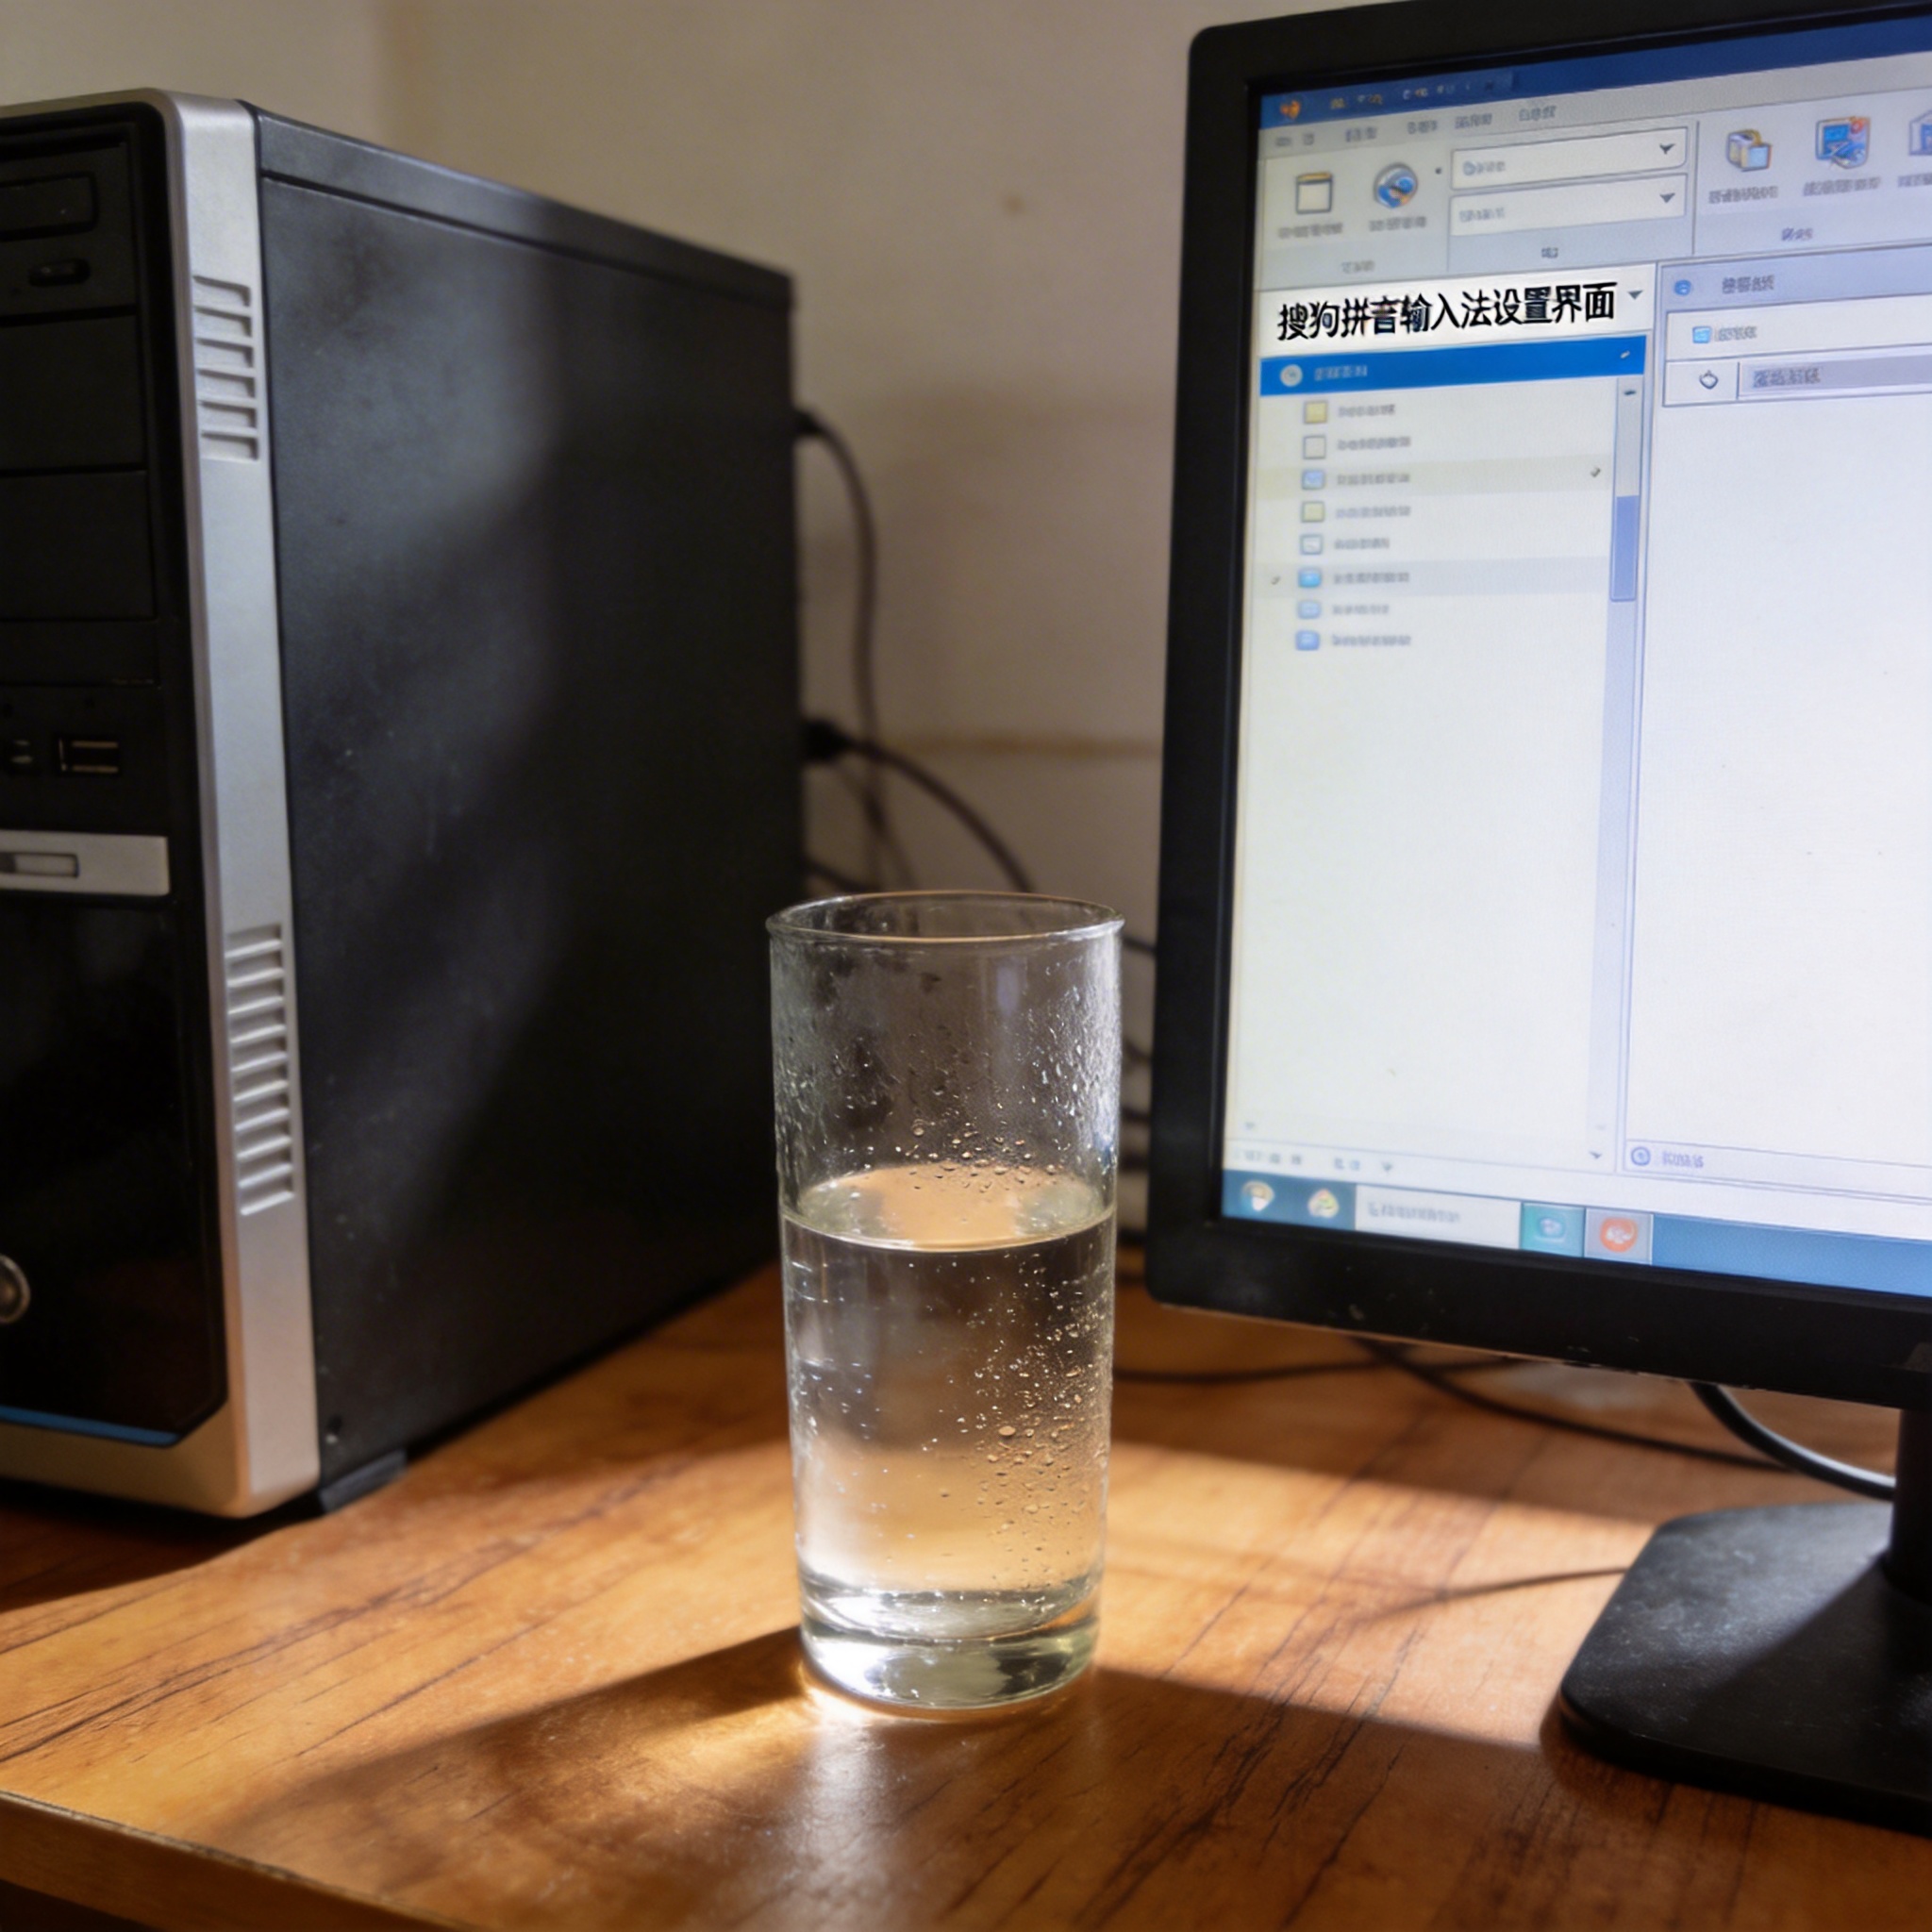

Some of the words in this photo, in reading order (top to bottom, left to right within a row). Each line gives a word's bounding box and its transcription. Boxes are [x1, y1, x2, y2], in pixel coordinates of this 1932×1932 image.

[1277, 282, 1618, 341] 搜狗拼音输入法设置界面
